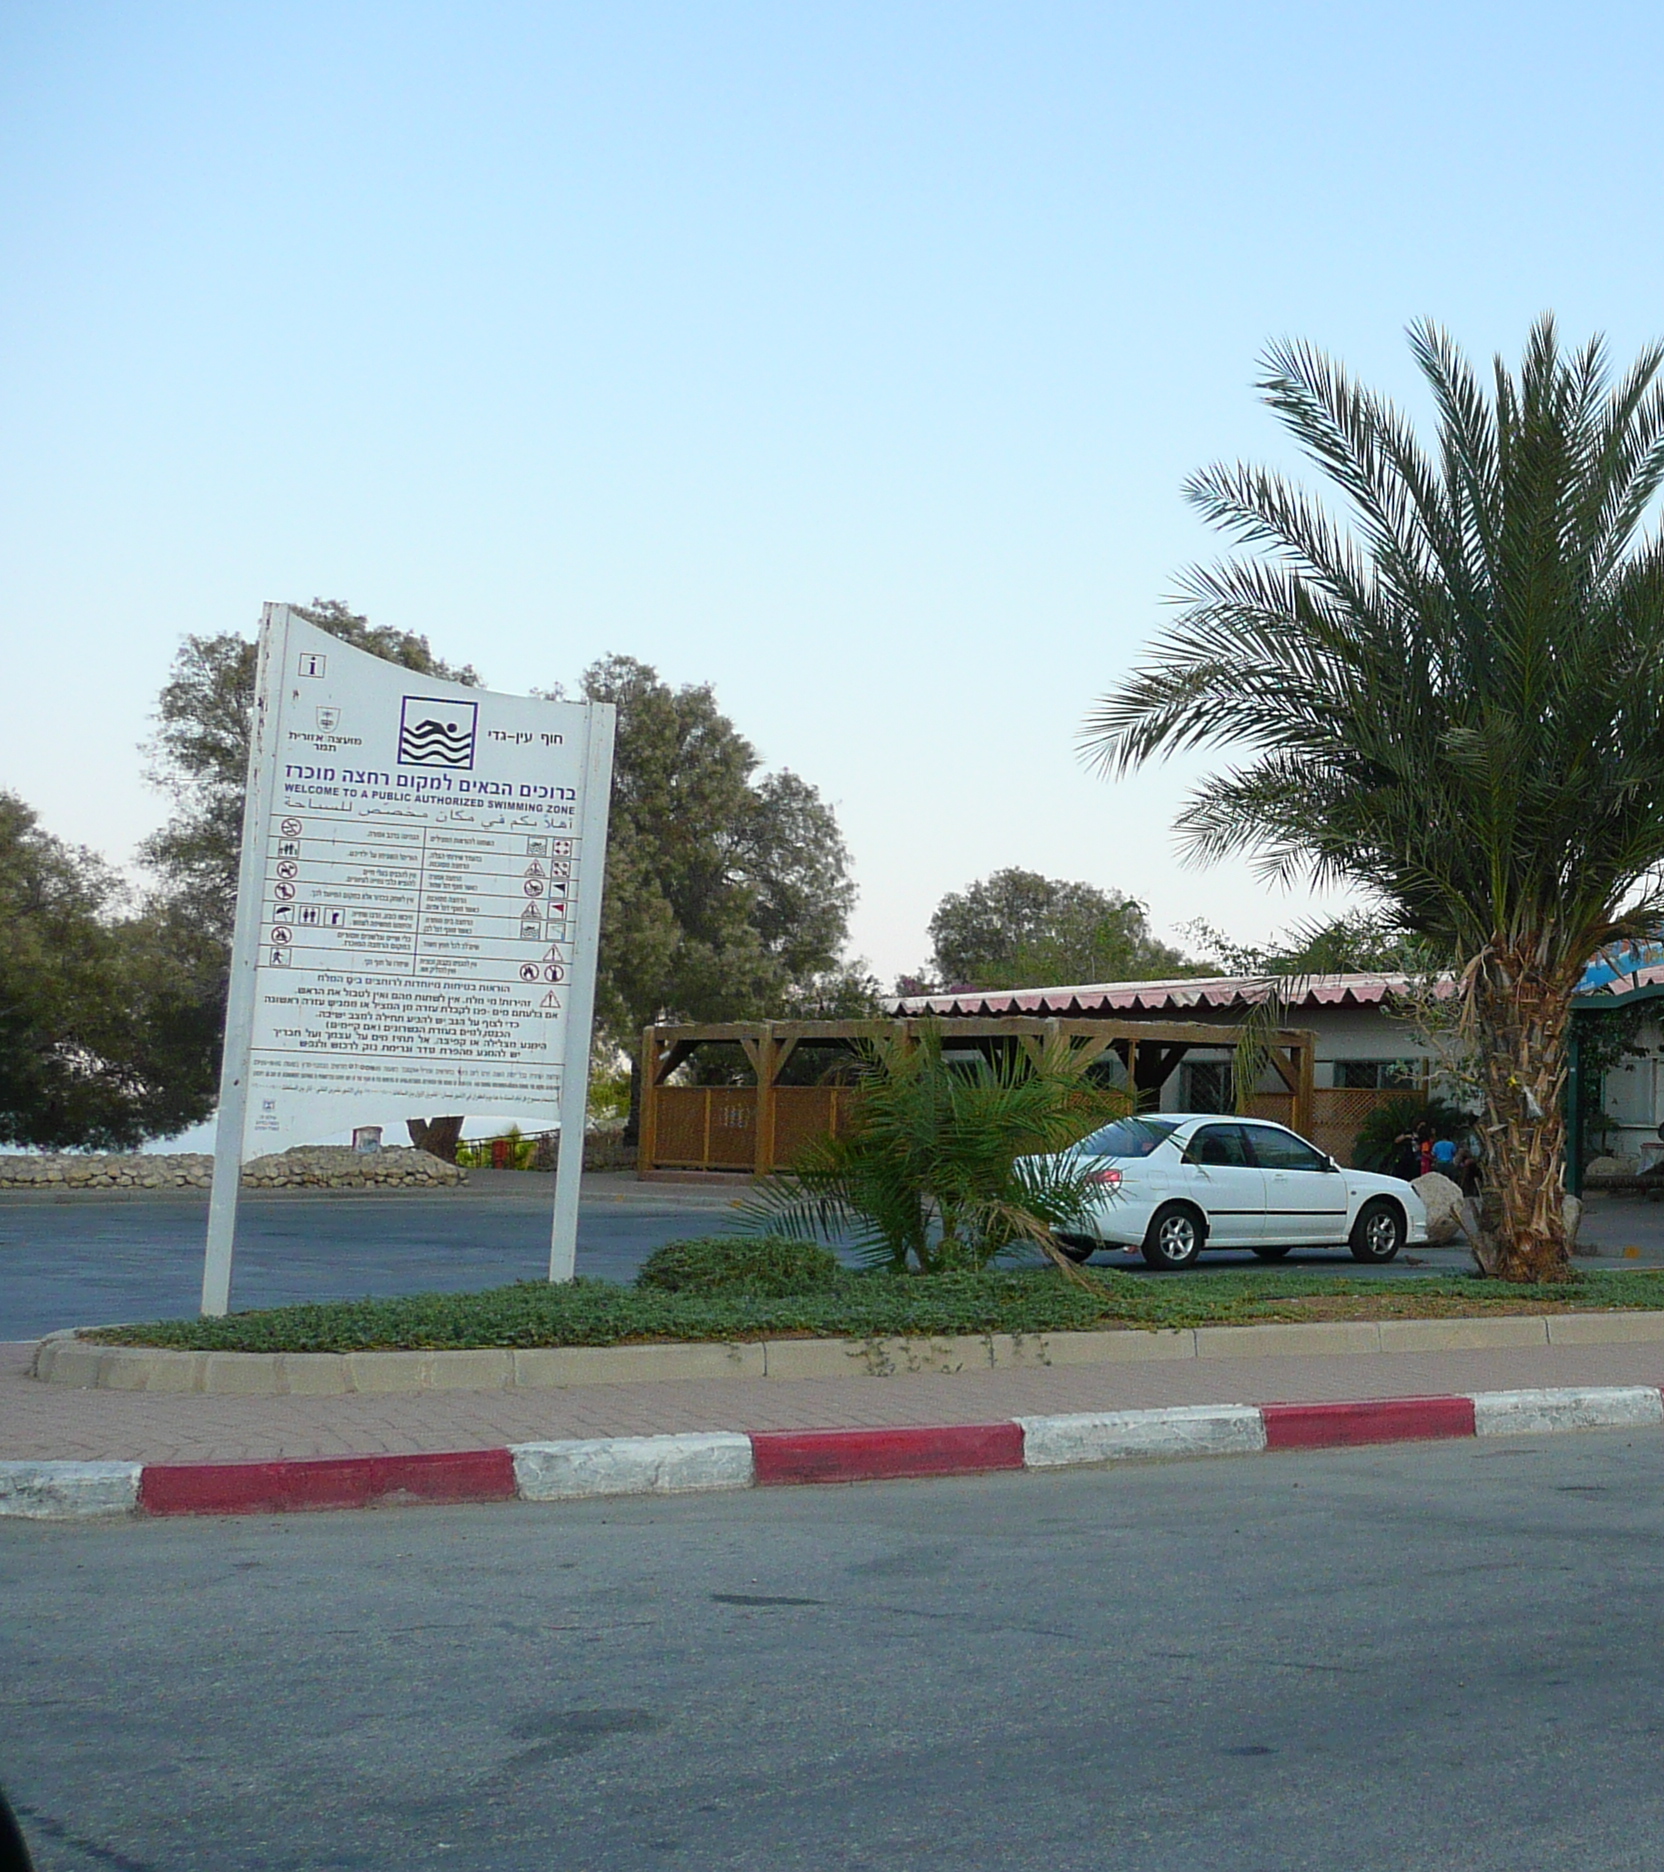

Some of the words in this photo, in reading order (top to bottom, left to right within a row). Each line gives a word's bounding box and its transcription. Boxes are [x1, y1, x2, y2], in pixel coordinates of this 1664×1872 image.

[289, 731, 323, 741] אזורית
[328, 736, 361, 745] מועצה
[541, 734, 562, 746] חוף
[313, 743, 336, 752] תמר
[285, 765, 334, 781] מוכרז
[342, 770, 389, 785] רחצה
[397, 773, 452, 792] למקום
[459, 780, 512, 795] הבאים
[520, 785, 575, 800] ברוכים
[285, 783, 338, 795] WELCOME
[343, 788, 357, 797] TO
[361, 790, 367, 798] A
[372, 790, 410, 801] PUBLIC
[414, 795, 483, 807] AUTHORIZED
[488, 800, 542, 812] SWIMMING
[546, 805, 574, 814] ZONE
[436, 810, 474, 822] مكان
[481, 815, 504, 827] في
[318, 974, 343, 982] המלח
[373, 992, 388, 1001] ואין
[448, 996, 460, 1005] אין
[403, 1004, 412, 1012] מן
[468, 1017, 479, 1026] על
[355, 1030, 367, 1040] על
[418, 1035, 429, 1043] אל
